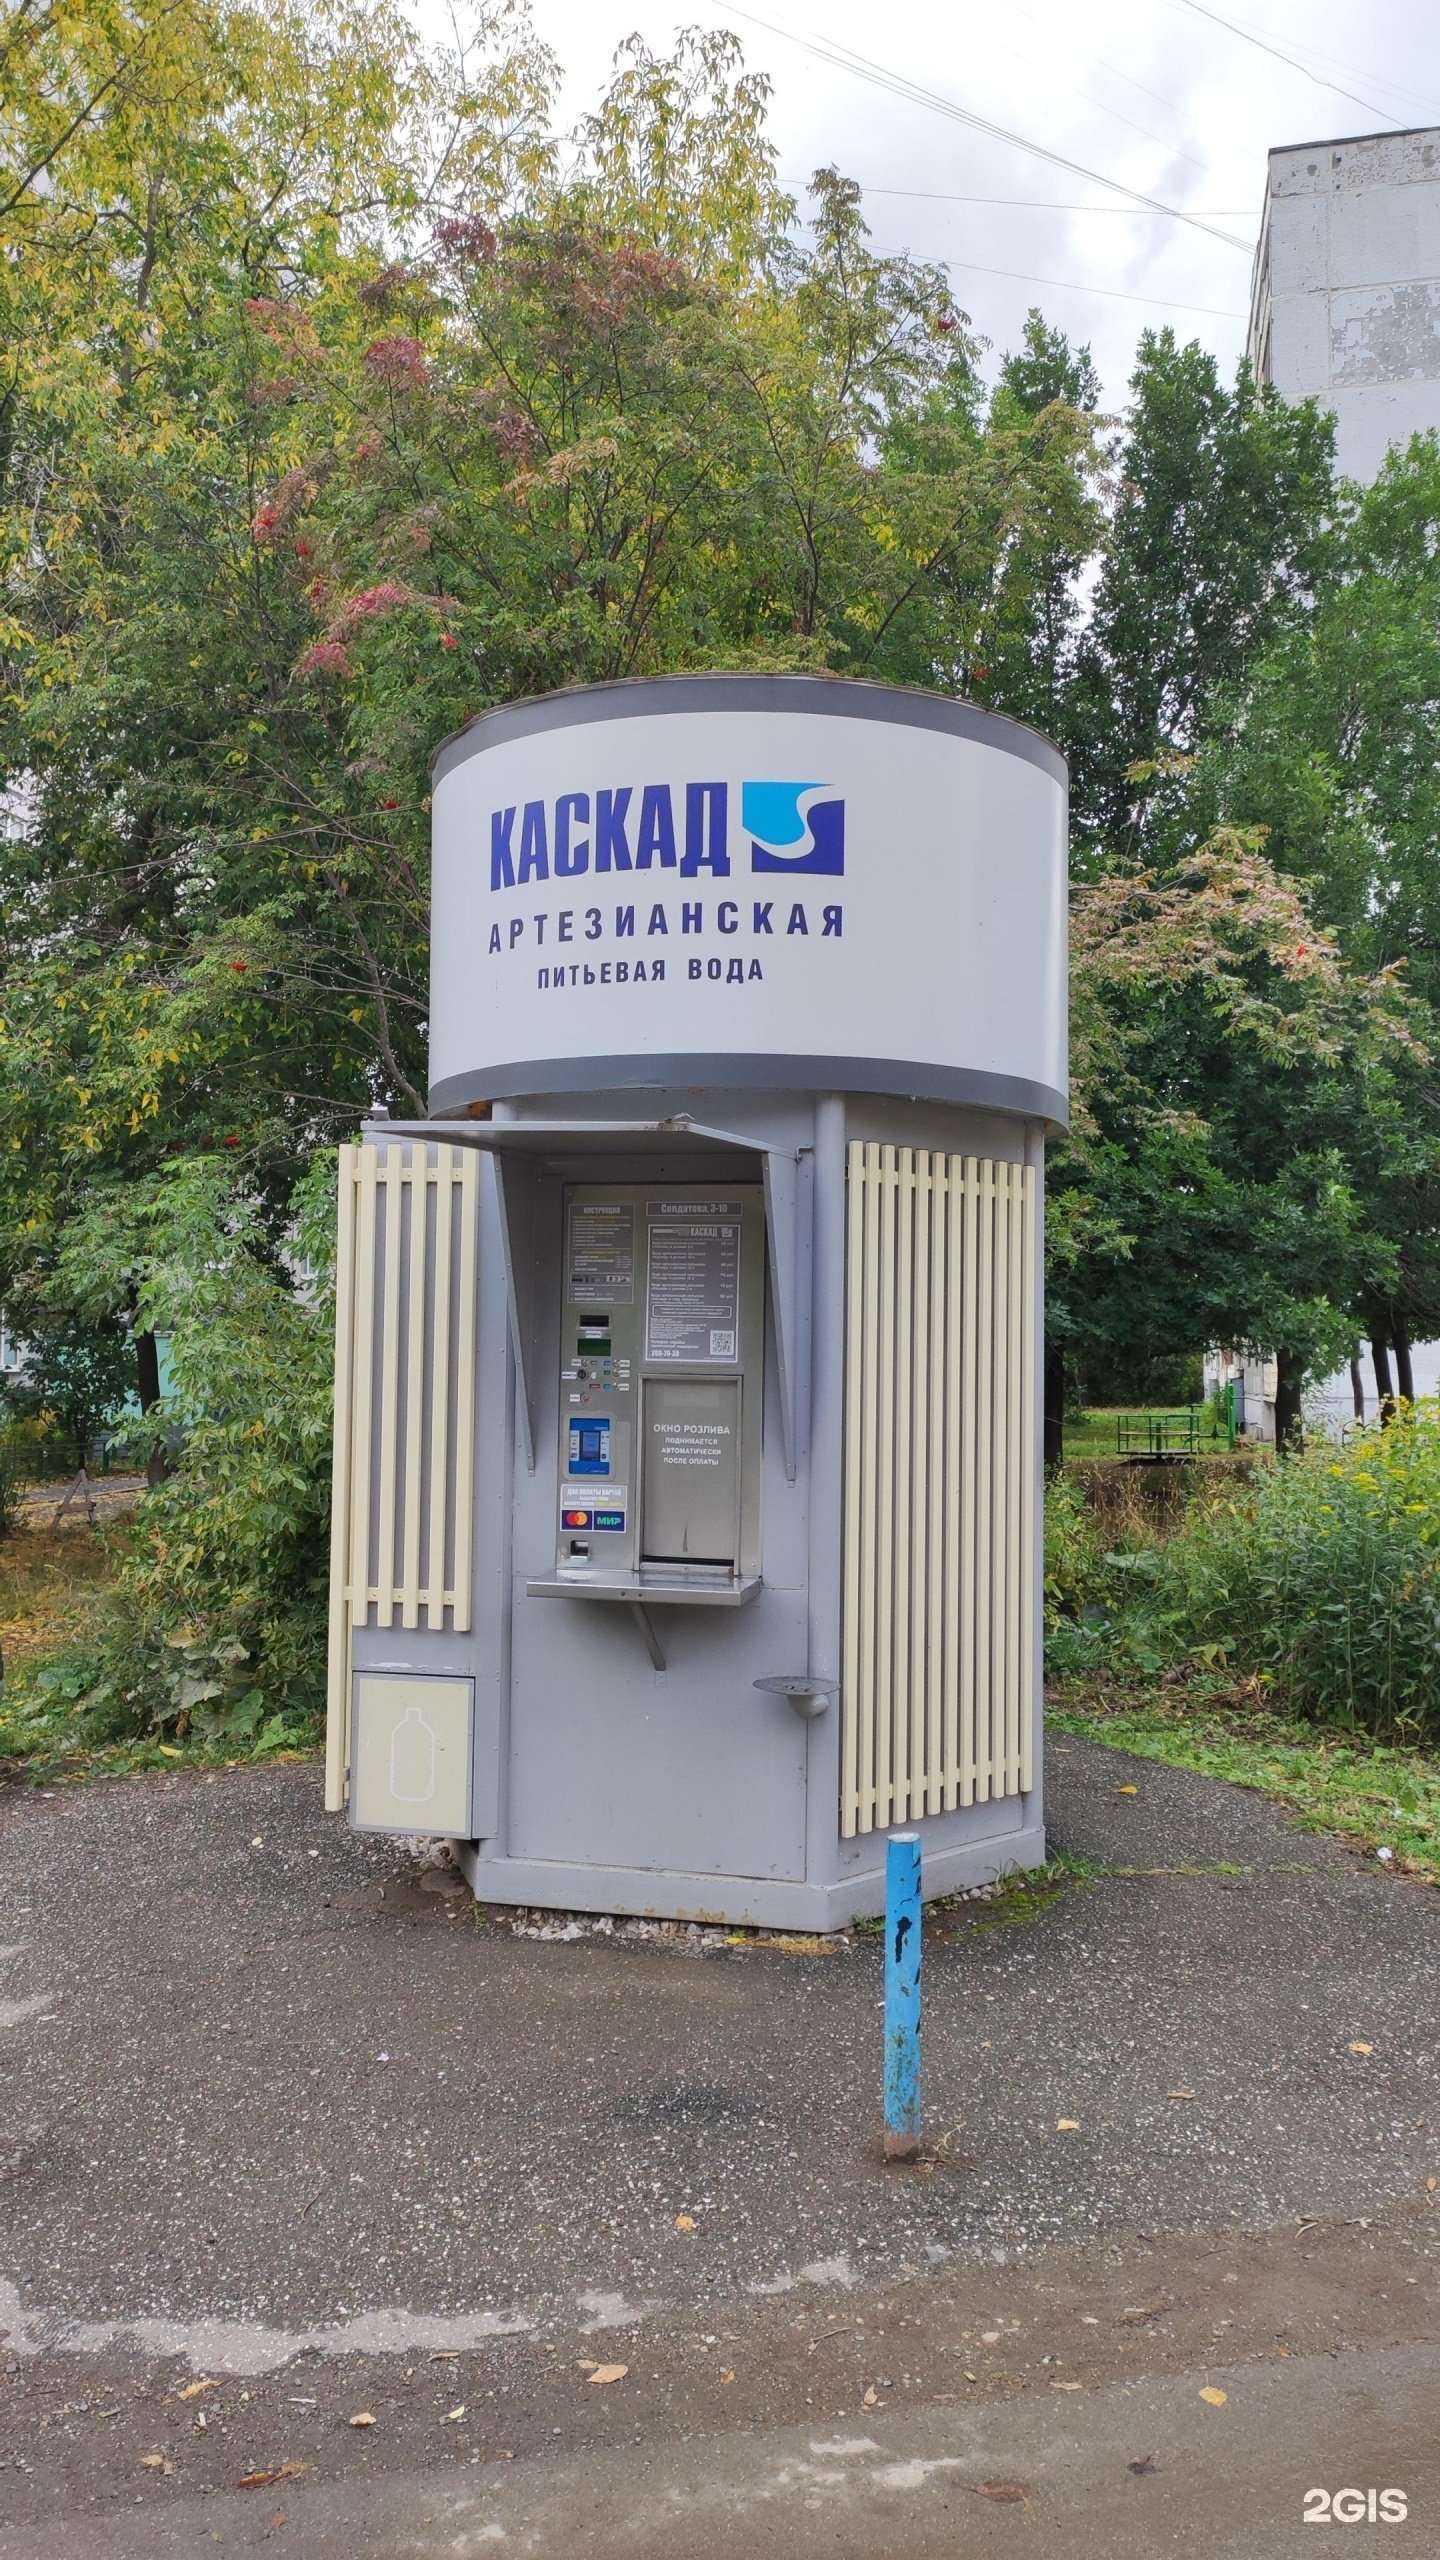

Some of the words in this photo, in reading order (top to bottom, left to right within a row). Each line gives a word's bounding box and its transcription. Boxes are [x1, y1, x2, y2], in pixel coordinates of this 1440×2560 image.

[490, 781, 731, 892] КАСКАД
[488, 901, 844, 954] АРТЕЗИАНСКАЯ
[537, 959, 666, 990] ПИТЬЕВАЯ
[687, 958, 763, 984] ВОДА
[653, 1424, 681, 1433] ОКНО
[683, 1425, 730, 1435] РОЗЛИВА
[664, 1437, 718, 1445] ПОДНИМАЕТСЯ
[661, 1447, 722, 1455] АВТОМАТИЧЕСКИ
[663, 1457, 687, 1465] ПОСЛЕ
[688, 1458, 719, 1466] ОПЛАТЫ
[596, 1516, 622, 1526] МИР
